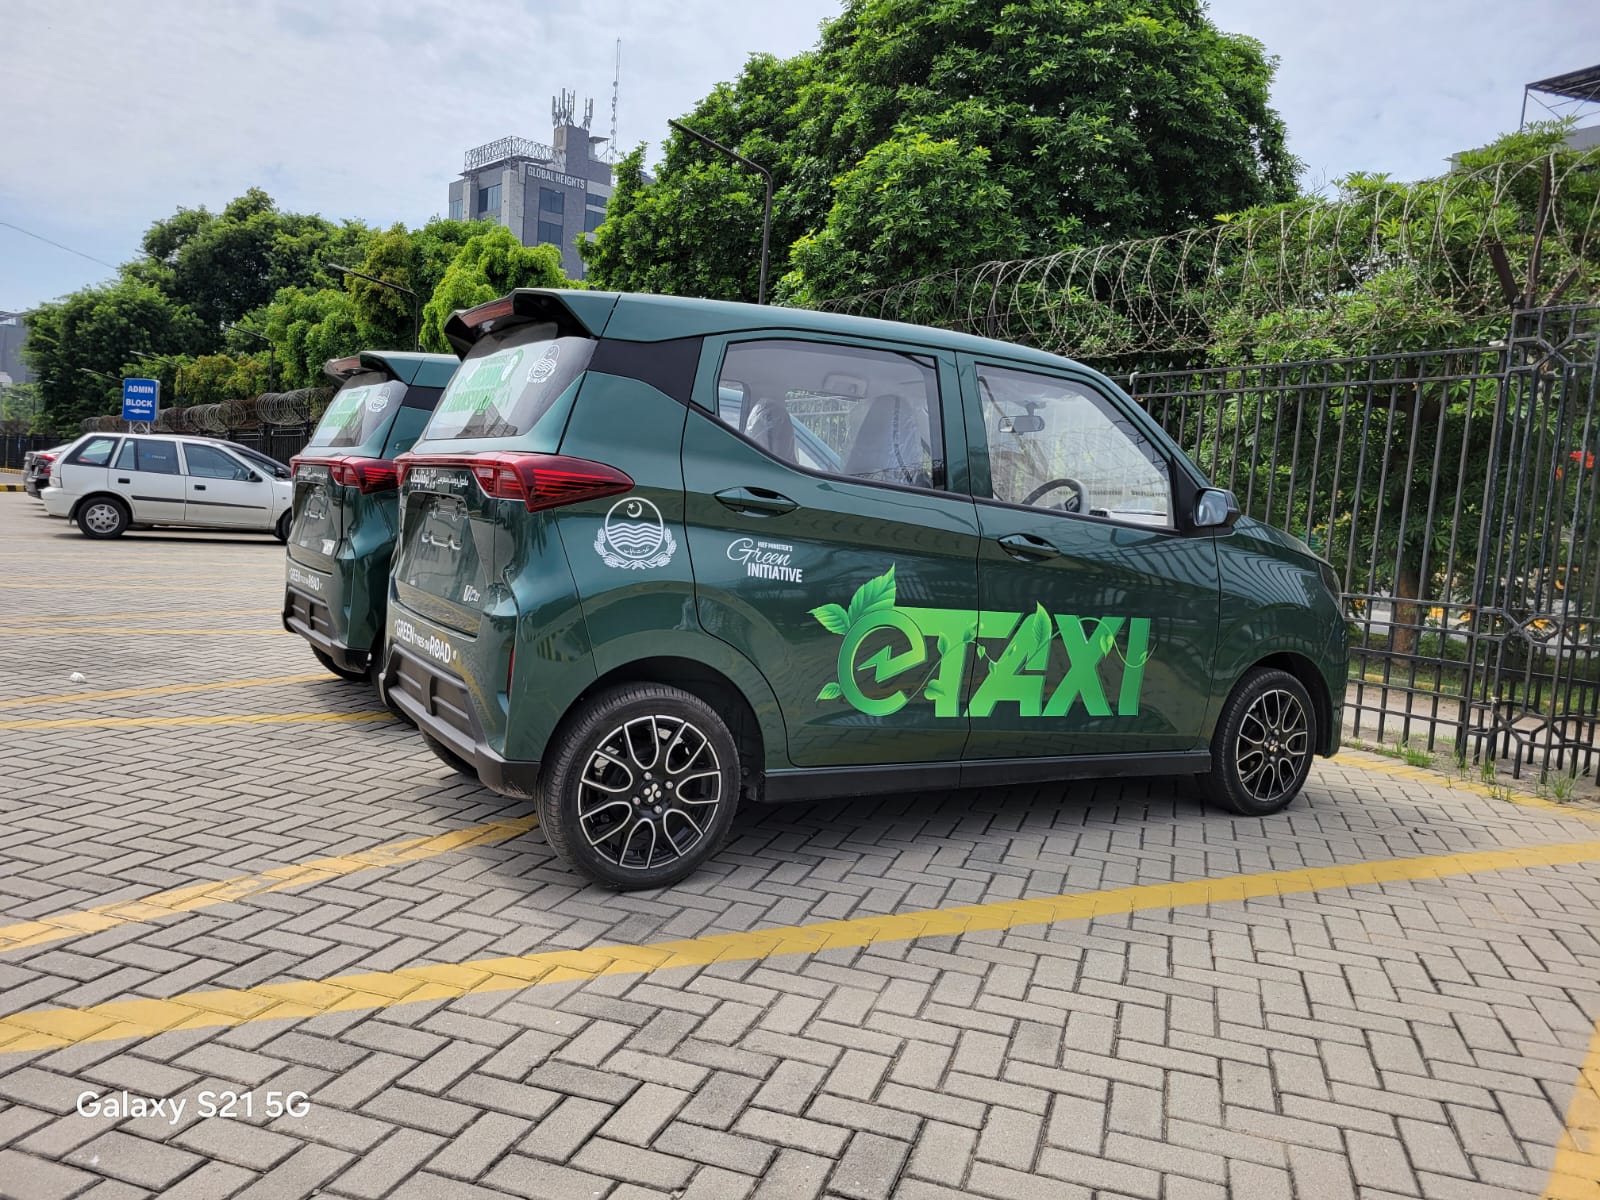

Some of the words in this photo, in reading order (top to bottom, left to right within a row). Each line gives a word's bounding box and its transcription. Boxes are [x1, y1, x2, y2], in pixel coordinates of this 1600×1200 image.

[527, 166, 555, 182] GLOBAL
[555, 174, 585, 189] HEIGHTS
[127, 385, 154, 394] ADMIN
[125, 398, 153, 408] BLOCK
[726, 537, 792, 566] Green
[747, 562, 803, 583] INITIATIVE
